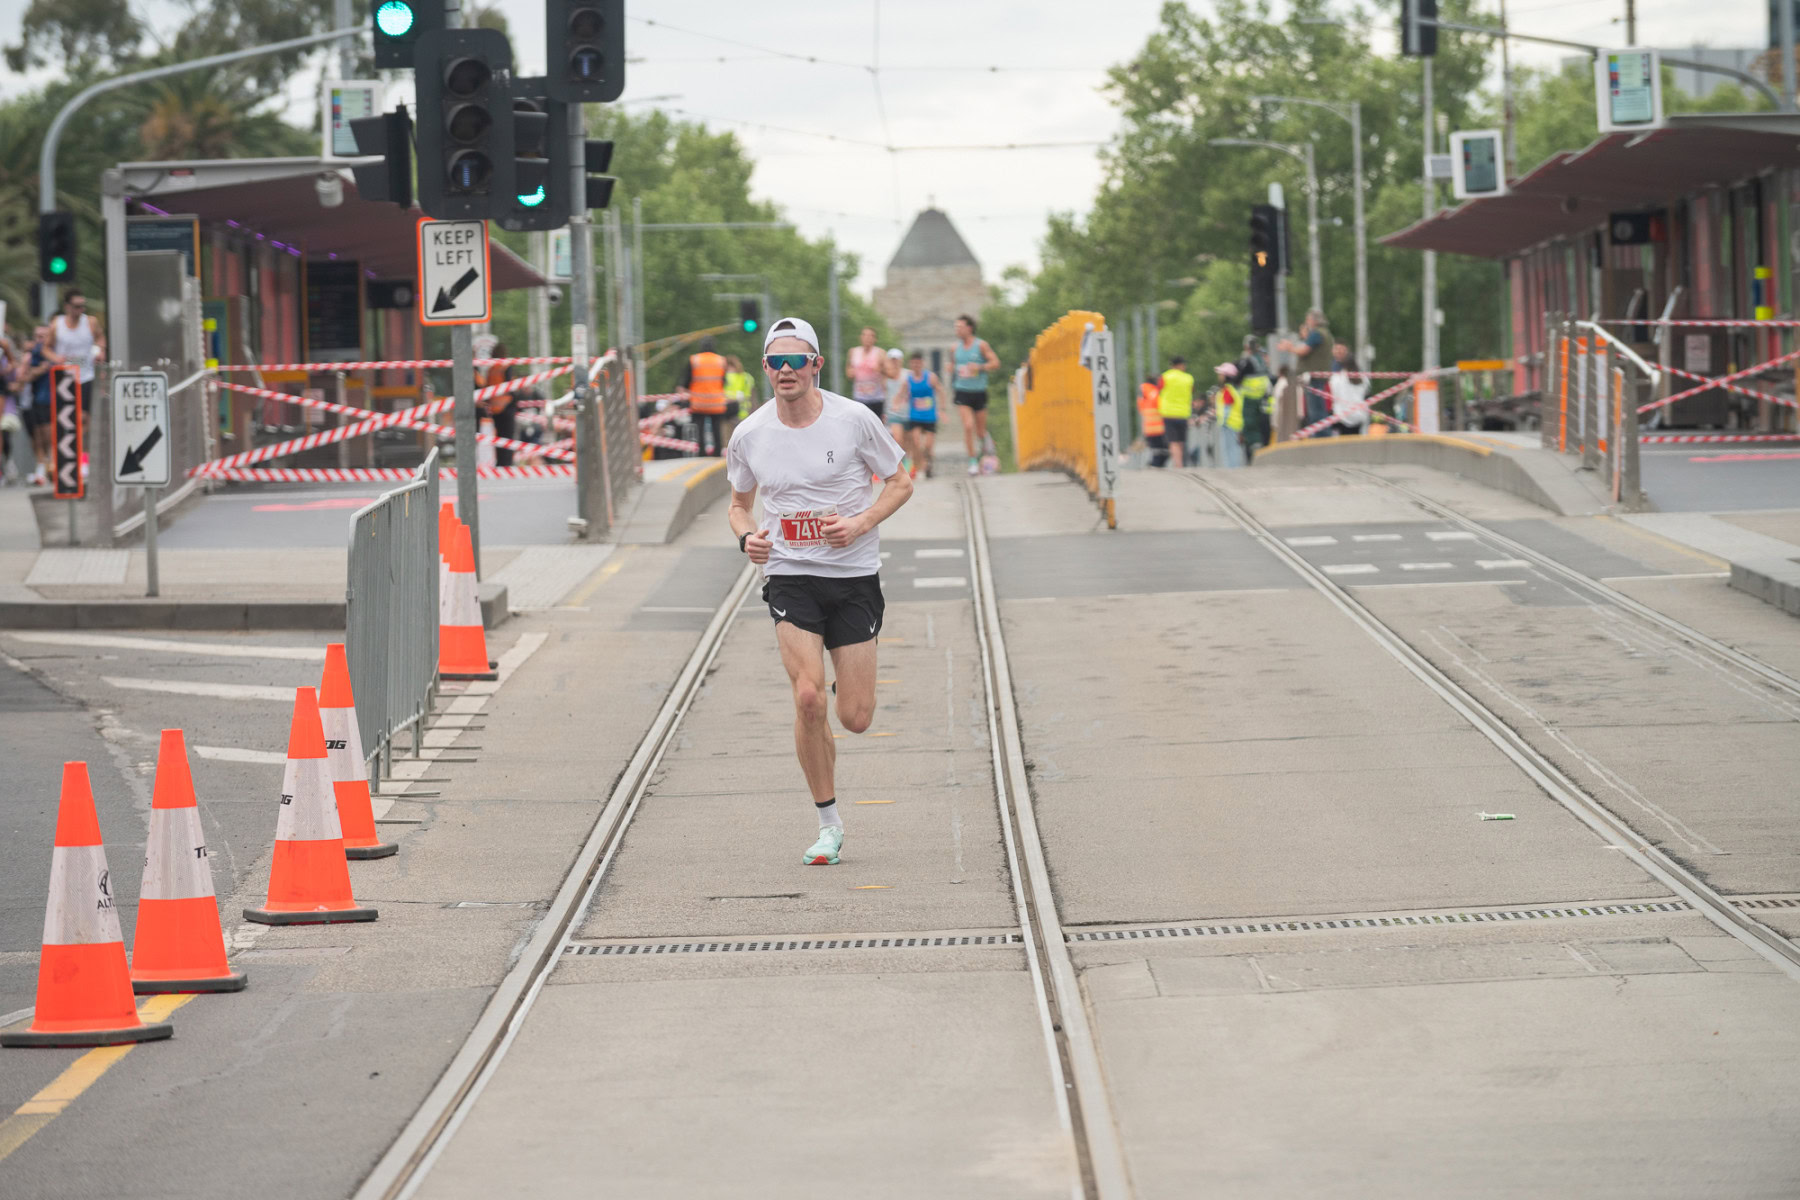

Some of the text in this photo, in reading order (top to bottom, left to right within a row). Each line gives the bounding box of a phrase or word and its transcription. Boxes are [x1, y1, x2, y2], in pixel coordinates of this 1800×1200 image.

[433, 229, 475, 245] KEEP
[435, 249, 473, 266] LEFT
[123, 382, 158, 398] KEEP
[125, 404, 158, 421] LEFT
[1096, 337, 1117, 493] TRAM ONLY
